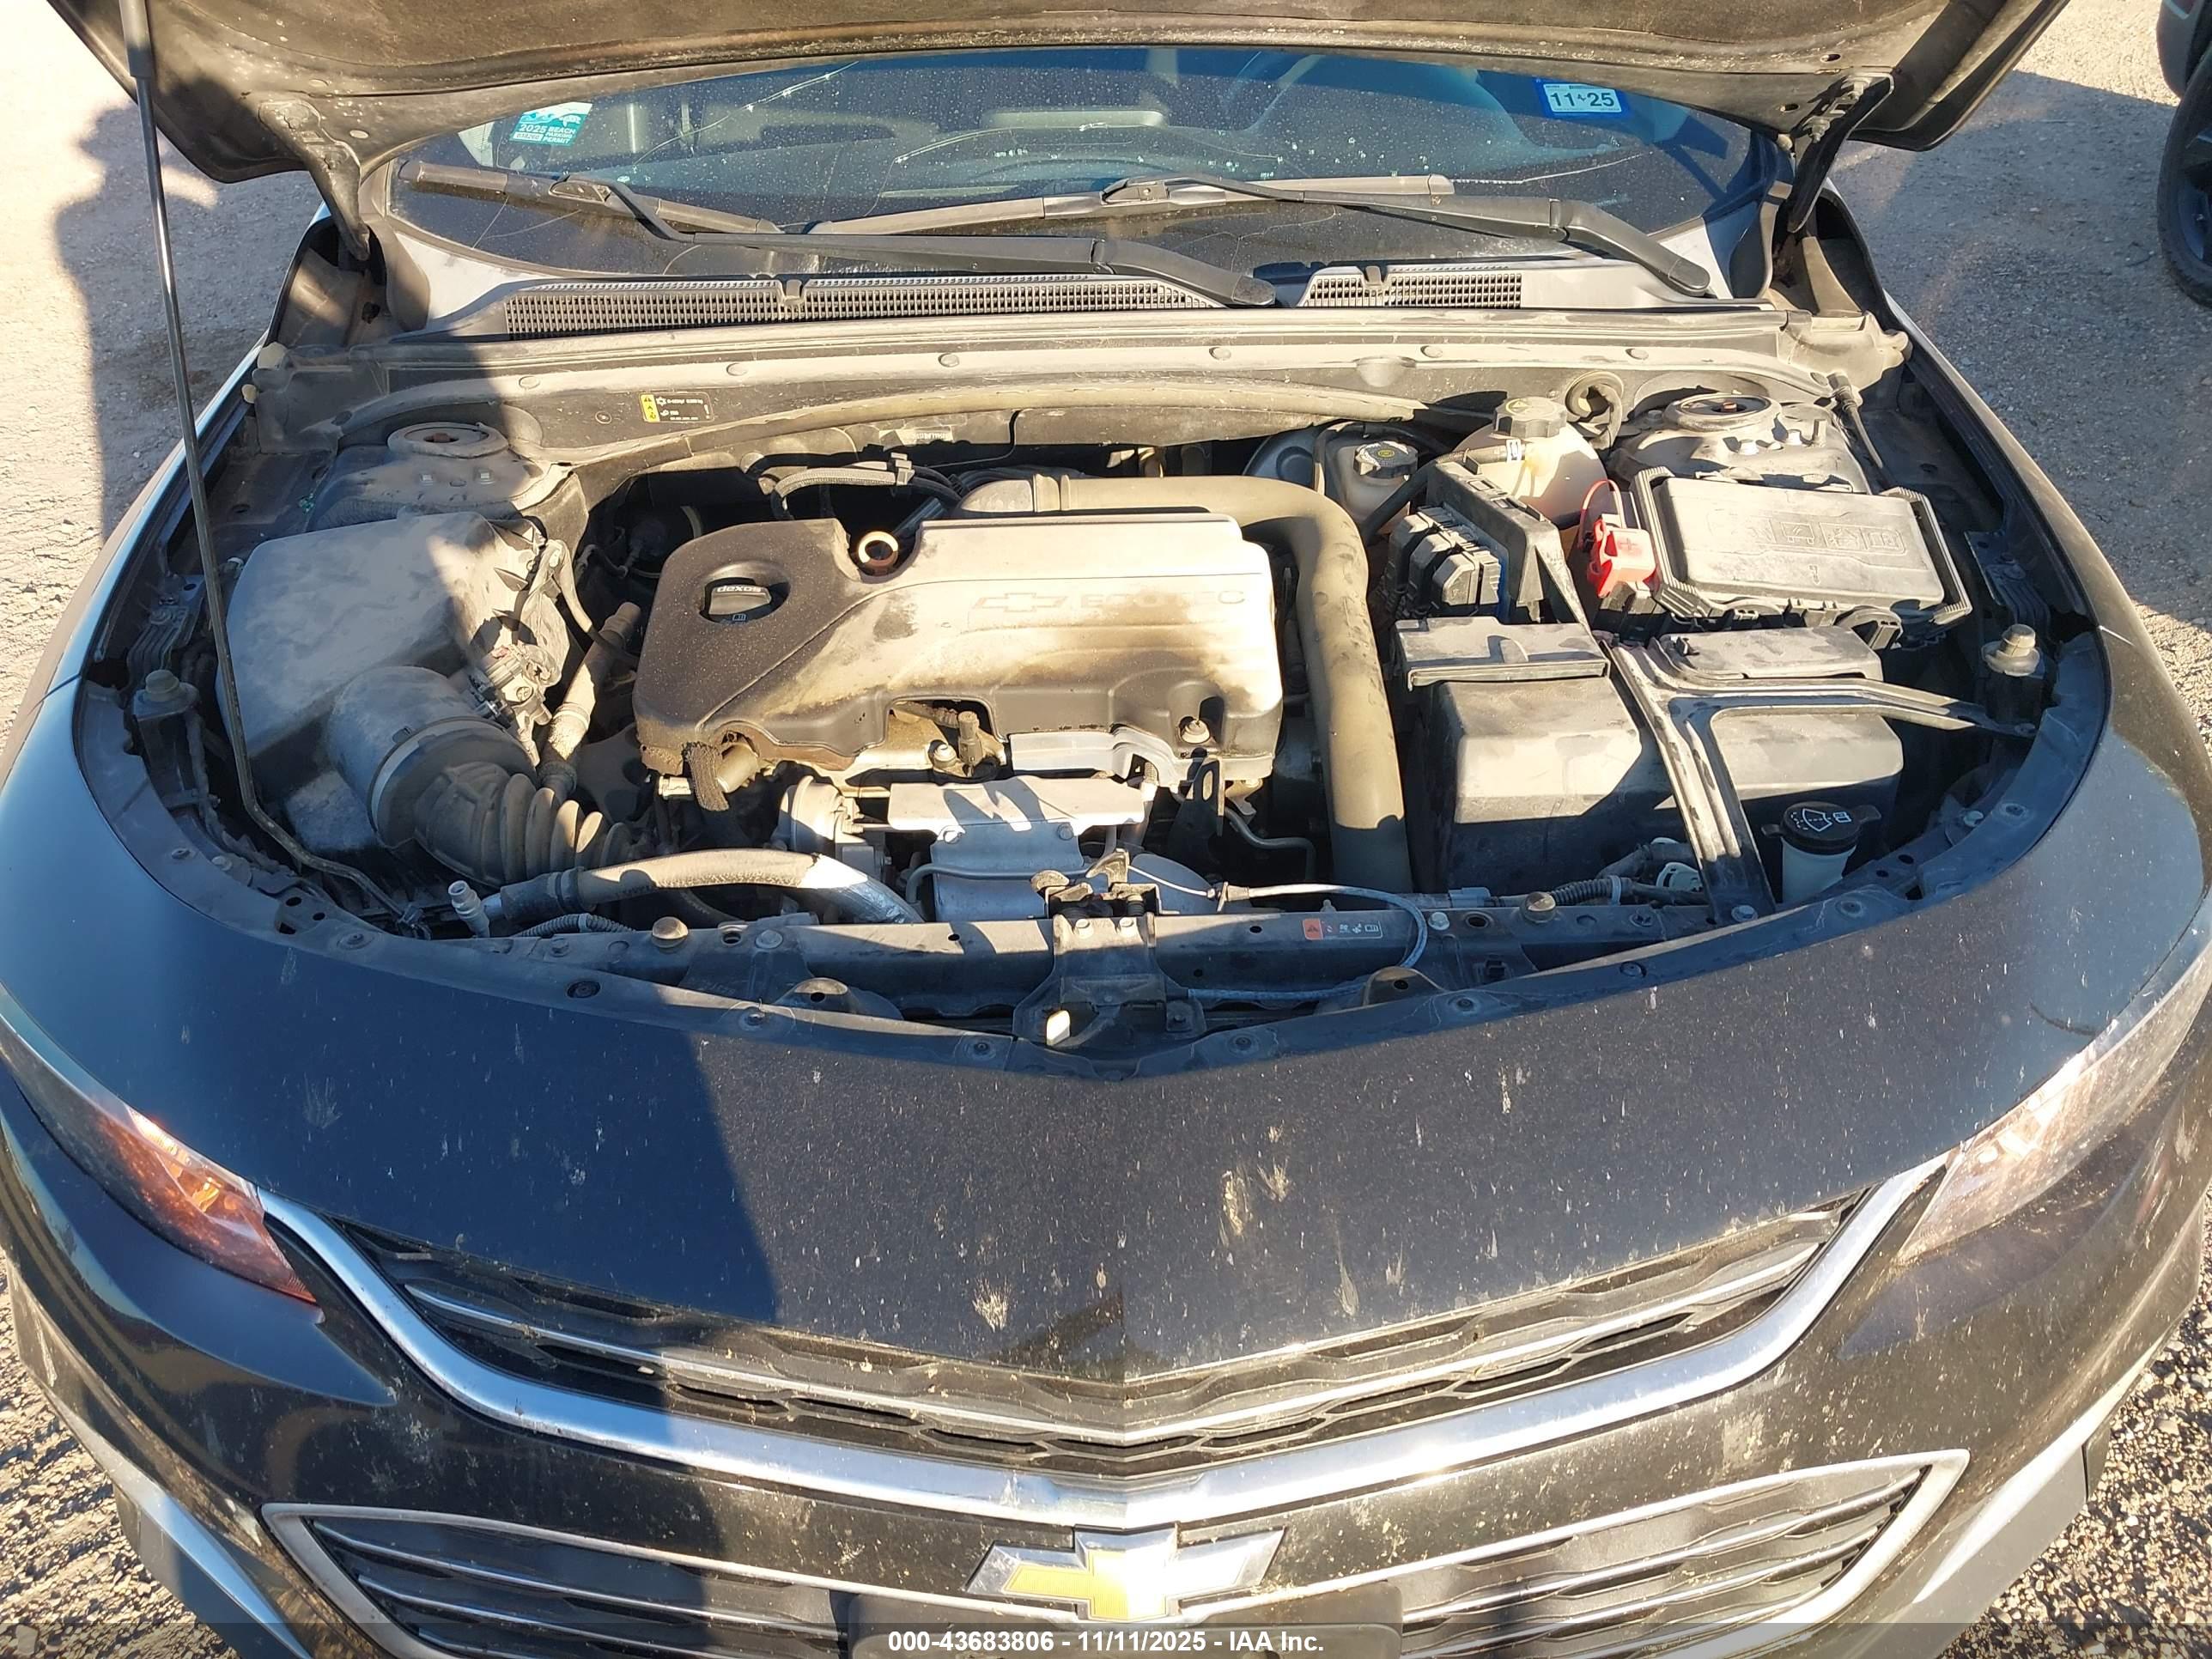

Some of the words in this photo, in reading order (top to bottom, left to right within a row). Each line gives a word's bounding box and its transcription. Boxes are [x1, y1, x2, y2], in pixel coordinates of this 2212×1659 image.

[1550, 92, 1575, 107] 11
[1587, 92, 1615, 107] 25
[519, 124, 548, 134] 2025
[547, 126, 577, 135] BEACH
[542, 136, 571, 144] PERMIT
[717, 585, 762, 593] dexos
